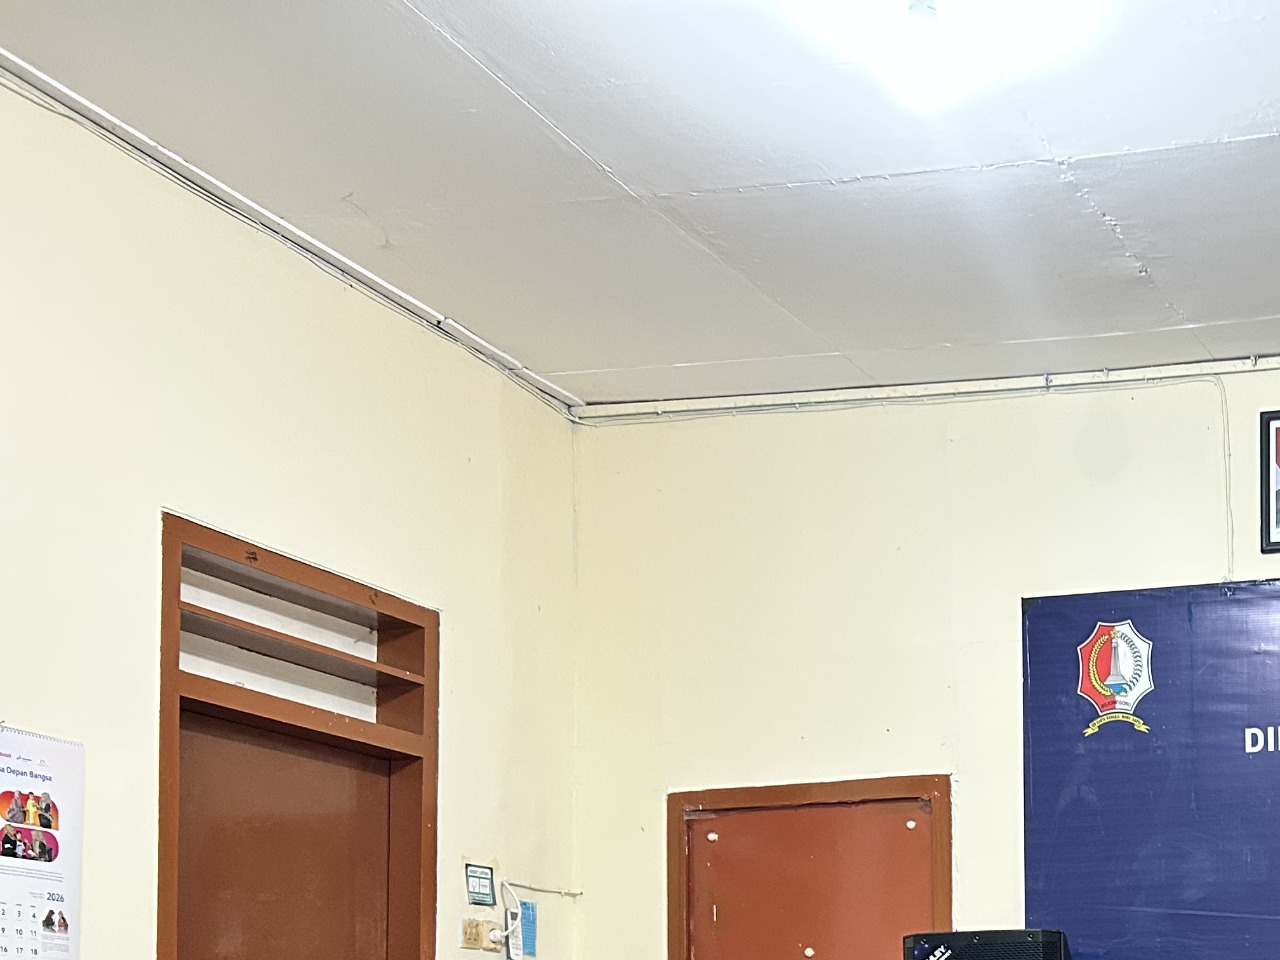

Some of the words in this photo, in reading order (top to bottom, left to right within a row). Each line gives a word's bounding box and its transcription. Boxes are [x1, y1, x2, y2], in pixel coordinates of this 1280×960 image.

[6, 766, 28, 777] Depan
[29, 770, 53, 782] Bangsa
[46, 892, 65, 902] 2026
[1, 908, 6, 916] 2
[17, 910, 21, 918] 3
[15, 928, 23, 936] 10
[30, 948, 38, 956] 18
